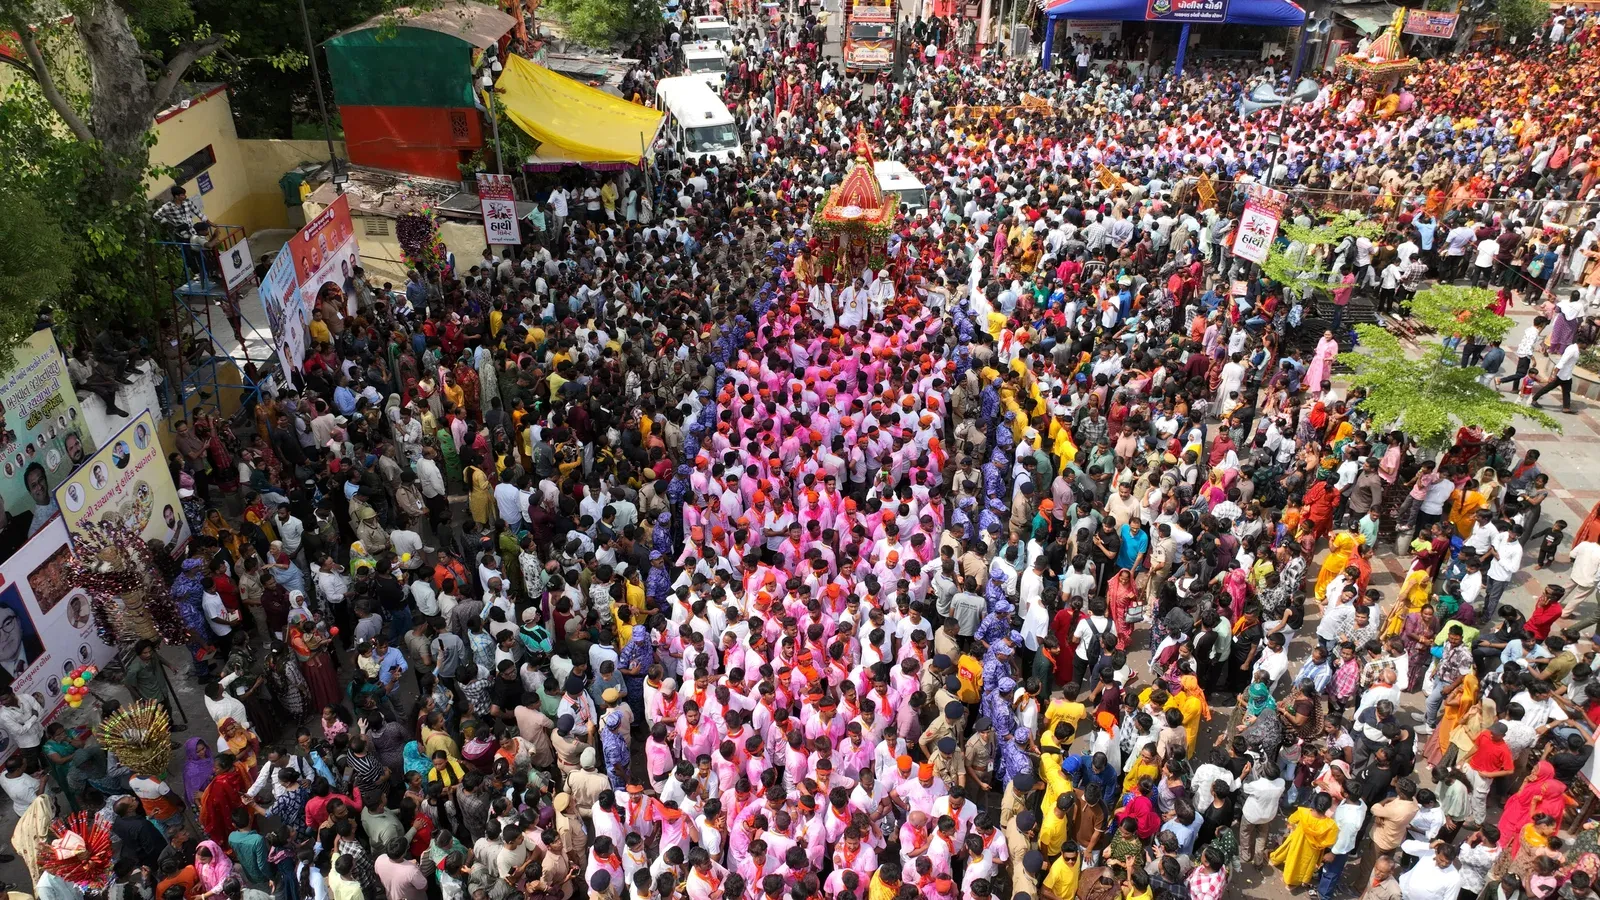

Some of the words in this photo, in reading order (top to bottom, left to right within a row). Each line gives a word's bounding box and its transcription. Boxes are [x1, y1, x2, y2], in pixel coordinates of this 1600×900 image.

[1204, 0, 1222, 9] ચોકી
[491, 220, 511, 231] હાથી
[1242, 234, 1264, 248] હાથી
[6, 384, 31, 410] ભગવાન
[27, 389, 52, 410] રથયાત્રા
[94, 489, 115, 511] રથયાત્રા
[120, 469, 135, 487] હાર્દિક
[134, 454, 152, 473] સ્વાગત
[14, 666, 40, 692] લલિતકુમાર
